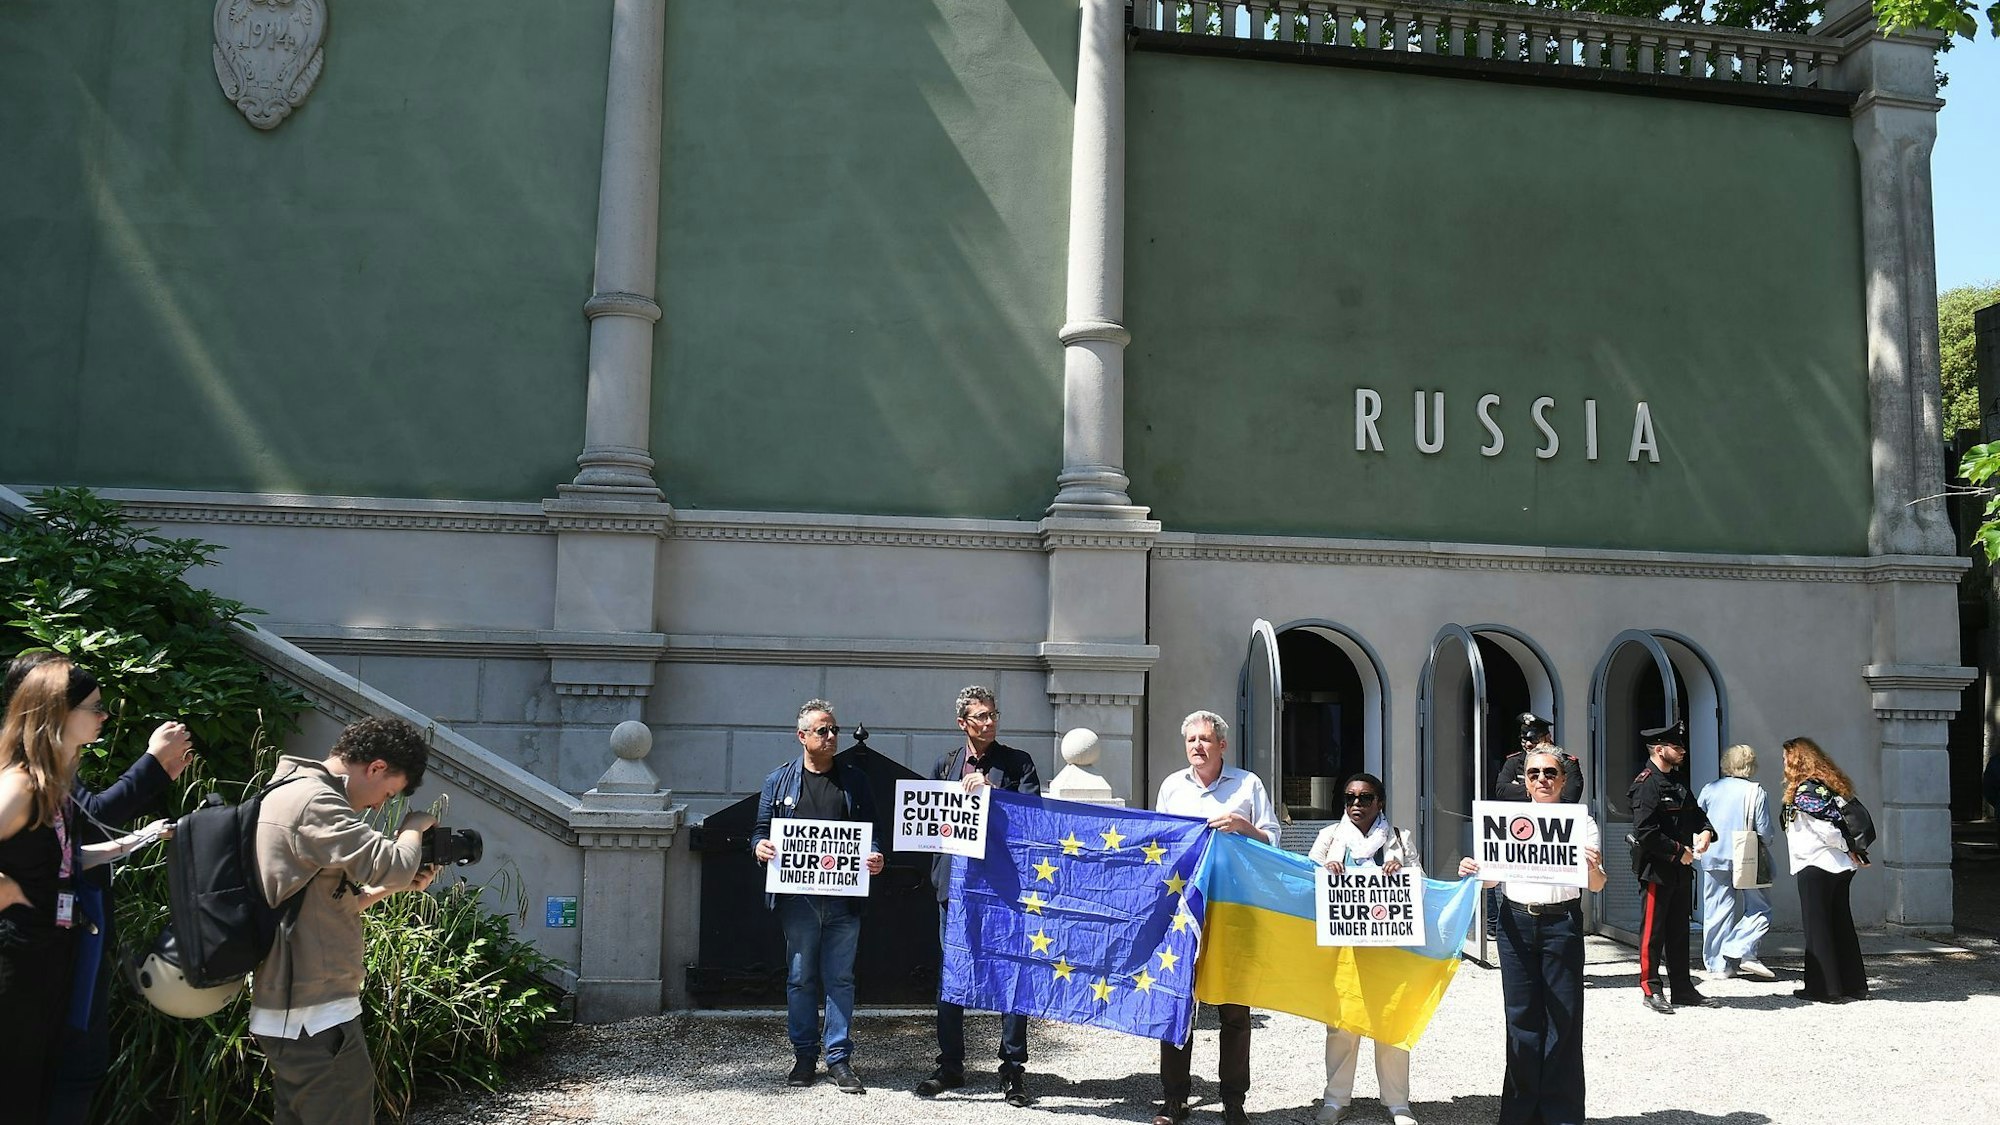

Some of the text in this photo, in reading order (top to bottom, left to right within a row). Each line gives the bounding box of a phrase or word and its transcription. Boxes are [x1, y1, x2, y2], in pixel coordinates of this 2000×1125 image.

[238, 18, 296, 51] 1914
[1355, 388, 1660, 463] RUSSIA
[903, 807, 980, 826] CULTURE
[783, 825, 862, 841] UKRAINE
[902, 822, 978, 841] IS A BOMB
[1483, 815, 1575, 843] NOW
[782, 838, 860, 855] UNDER ATTACK
[1483, 841, 1578, 866] IN UKRAINE
[781, 853, 861, 871] EUROPE
[780, 870, 859, 886] UNDER ATTACK
[1327, 874, 1411, 888] UKRAINE
[1328, 889, 1411, 903] UNDER ATTACK
[1329, 904, 1413, 920] EUROPE
[1329, 921, 1414, 936] UNDER ATTACK
